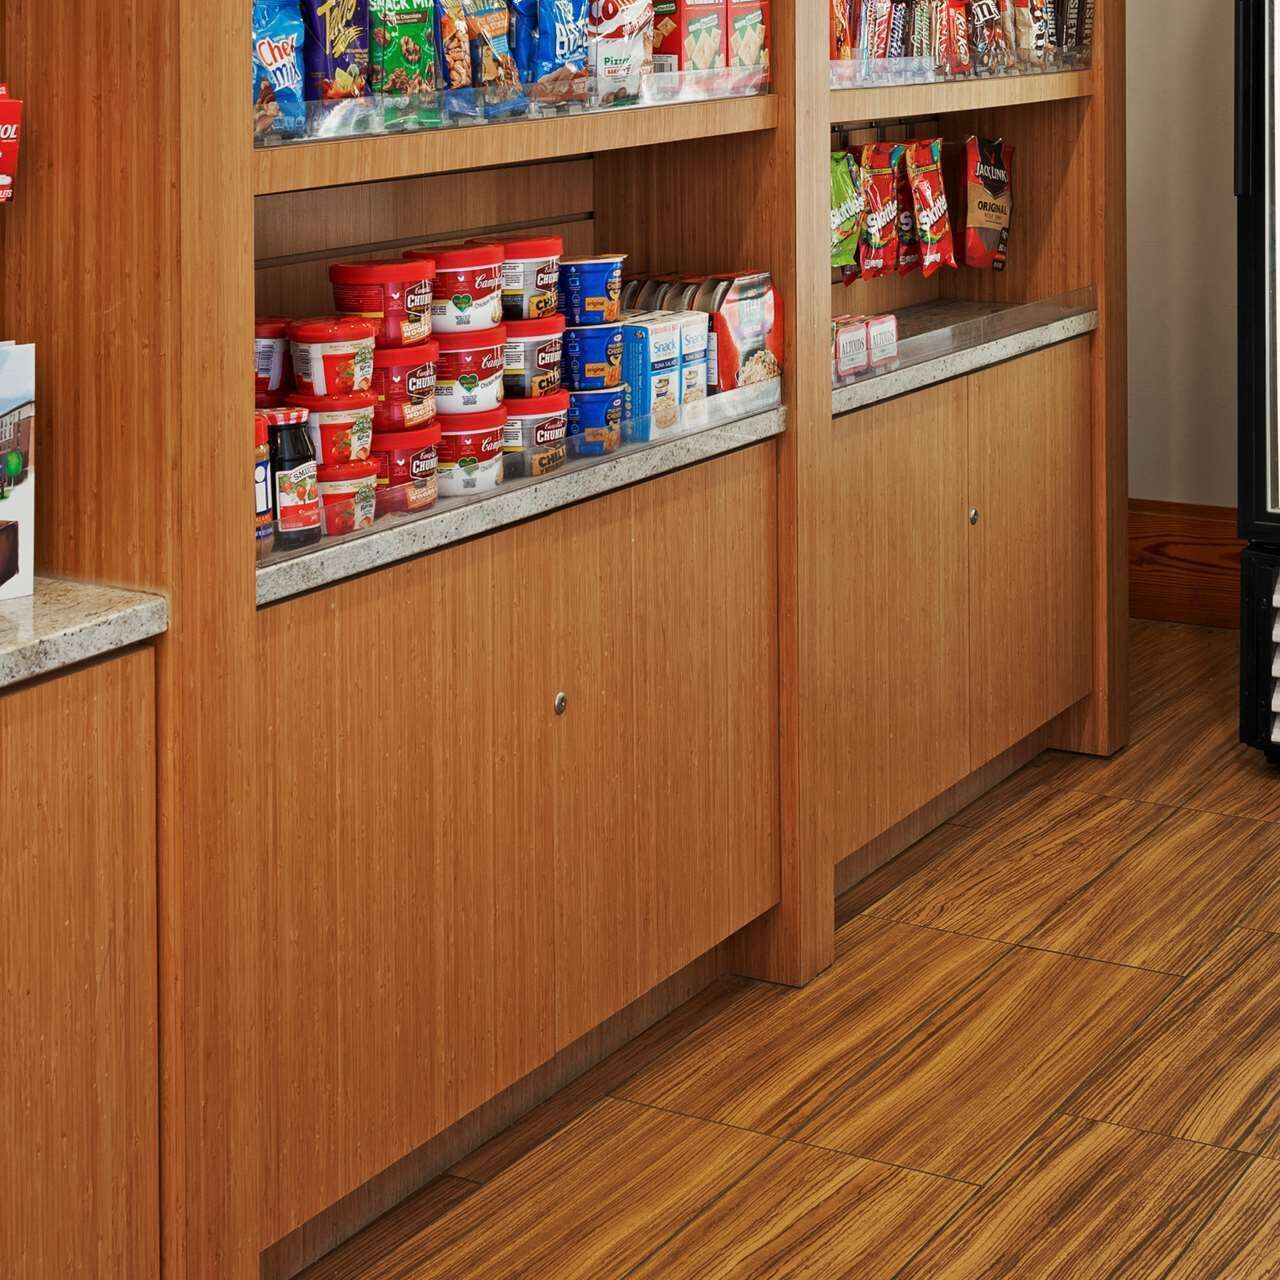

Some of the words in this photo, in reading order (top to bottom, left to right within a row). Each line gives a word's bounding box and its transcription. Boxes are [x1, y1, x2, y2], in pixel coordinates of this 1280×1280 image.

[977, 200, 1009, 216] ORIGINAL
[872, 328, 895, 346] ALTOIDS
[653, 341, 676, 354] Snack
[841, 337, 865, 356] ALTOIDS
